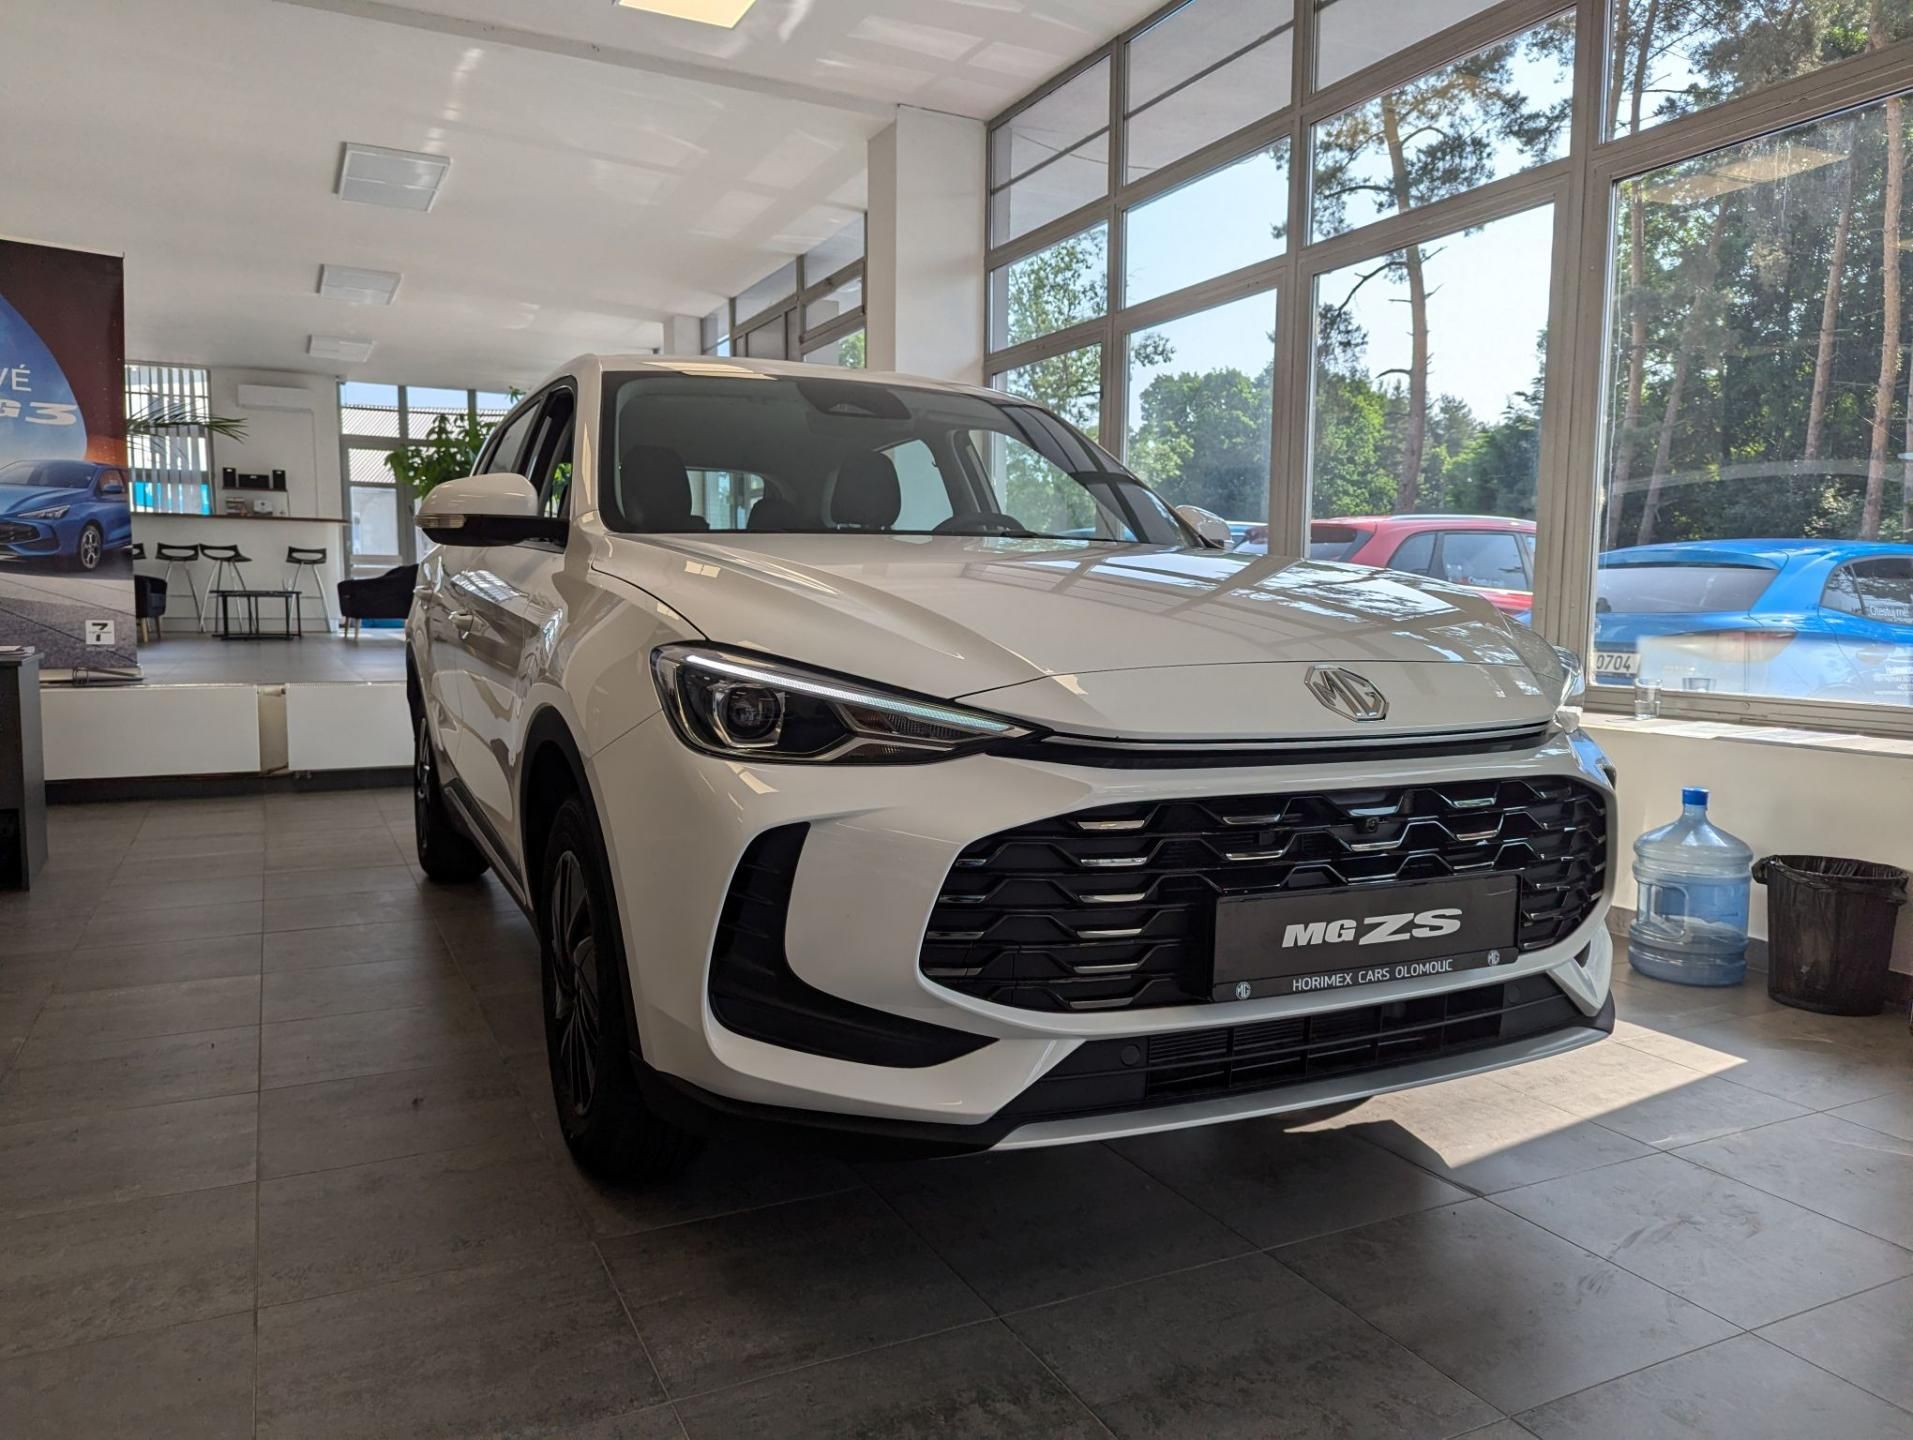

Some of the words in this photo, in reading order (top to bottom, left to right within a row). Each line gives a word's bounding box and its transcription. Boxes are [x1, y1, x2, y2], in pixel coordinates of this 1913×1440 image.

[1310, 668, 1384, 717] MG
[1281, 919, 1356, 948] MG
[1358, 908, 1463, 945] ZS
[1235, 981, 1251, 1000] MG
[1292, 972, 1353, 992] HORIMEX
[1358, 967, 1390, 984] CARS
[1395, 959, 1453, 978] OLOMOUC
